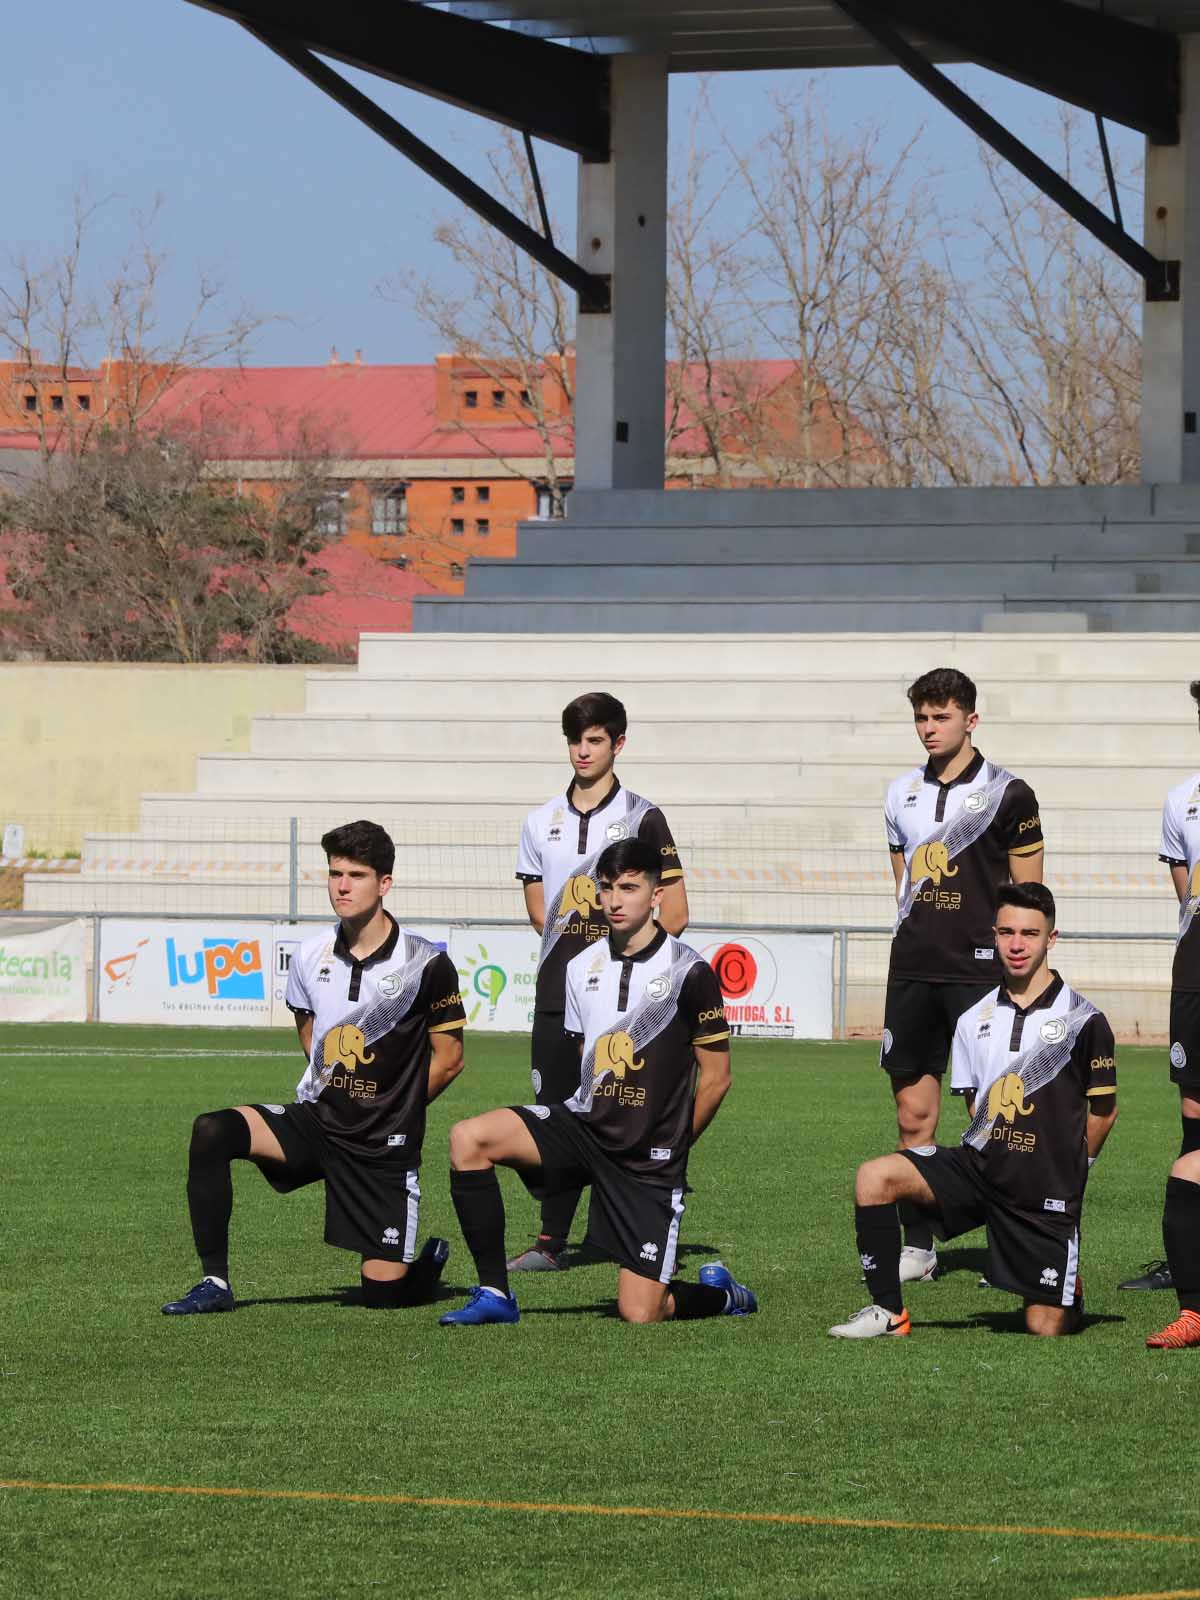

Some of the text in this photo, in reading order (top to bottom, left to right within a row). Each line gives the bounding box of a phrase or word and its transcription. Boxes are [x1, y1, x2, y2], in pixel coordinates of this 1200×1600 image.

[935, 902, 961, 910] grupo
[166, 937, 262, 995] lupa
[350, 1089, 376, 1099] grupo
[618, 1097, 645, 1108] grupo
[1007, 1142, 1034, 1153] grupo
